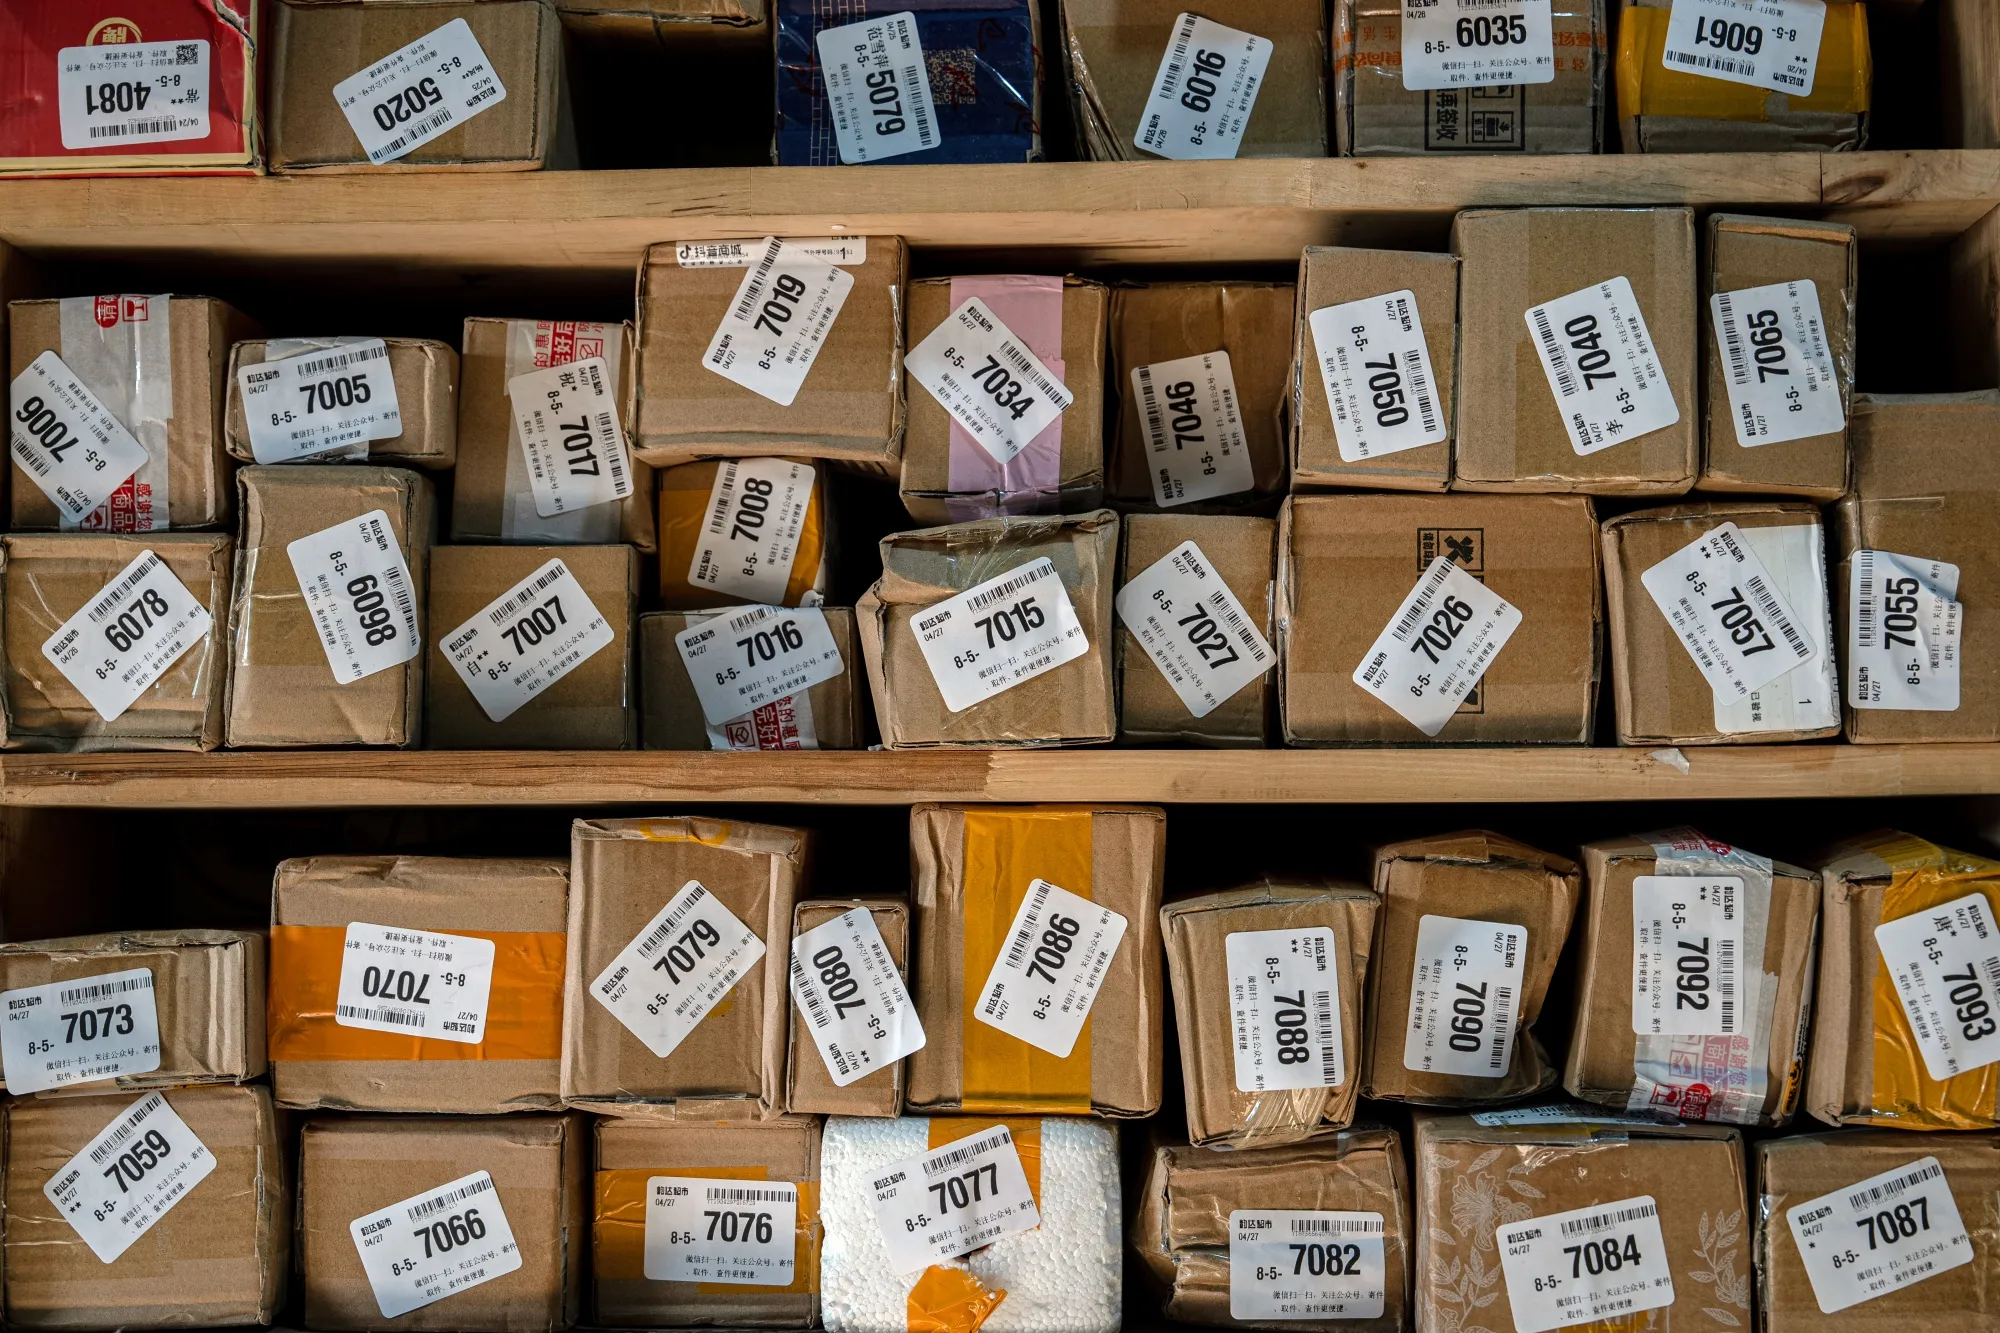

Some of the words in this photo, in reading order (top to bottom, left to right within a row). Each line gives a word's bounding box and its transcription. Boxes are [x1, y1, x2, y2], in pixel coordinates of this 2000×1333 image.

[886, 21, 897, 41] 04/25
[1424, 40, 1451, 55] 8-5-
[1455, 13, 1527, 48] 6035
[1694, 15, 1764, 56] 6061
[1771, 26, 1797, 42] 8-5-
[436, 56, 462, 75] 8-5-
[154, 74, 181, 88] 8-5-
[471, 76, 492, 92] 04/25
[853, 43, 870, 68] 8-5-
[865, 68, 906, 137] 5079
[1180, 48, 1227, 114] 6016
[85, 81, 152, 116] 4081
[372, 76, 444, 132] 5020
[178, 117, 199, 128] 04/24
[1436, 88, 1459, 141] 再签收
[1189, 120, 1207, 146] 8-5-
[694, 244, 742, 258] 抖音商城
[840, 246, 846, 260] 1
[752, 273, 807, 338] 7019
[1385, 300, 1397, 321] 04/27
[958, 313, 977, 331] 04/27
[722, 349, 737, 370] 04/27
[757, 346, 777, 370] 8-5-
[1564, 314, 1617, 392] 7040
[1746, 309, 1790, 384] 7065
[248, 383, 269, 395] 04/27
[578, 366, 590, 386] 04/27
[943, 346, 965, 370] 8-5-
[971, 353, 1036, 421] 7034
[1350, 325, 1369, 353] 8-5-
[1364, 351, 1410, 428] 7050
[271, 410, 298, 427] 8-5-
[298, 373, 372, 415] 7005
[1615, 387, 1636, 415] 8-5-
[1785, 385, 1803, 413] 8-5-
[1164, 380, 1206, 451] 7046
[1756, 415, 1768, 436] 04/27
[15, 395, 80, 464] 7006
[546, 390, 564, 416] 8-5-
[559, 414, 601, 477] 7017
[1589, 422, 1604, 443] 04/27
[85, 448, 107, 472] 8-5-
[1200, 450, 1217, 476] 8-5-
[73, 488, 92, 507] 04/27
[1172, 479, 1185, 498] 04/27
[136, 483, 153, 530] 感谢您
[729, 477, 774, 543] 7008
[1709, 537, 1728, 557] 04/27
[707, 563, 720, 584] 04/27
[741, 551, 758, 577] 8-5-
[1171, 556, 1189, 575] 04/27
[329, 550, 348, 577] 8-5-
[346, 574, 398, 647] 6098
[104, 588, 169, 653] 6078
[1685, 570, 1708, 597] 8-5-
[1710, 585, 1777, 658] 7057
[1883, 577, 1920, 651] 7055
[487, 660, 512, 681] 8-5-
[500, 594, 568, 657] 7007
[923, 626, 944, 642] 04/27
[953, 649, 980, 670] 8-5-
[973, 596, 1046, 650] 7015
[1152, 589, 1174, 614] 8-5-
[1177, 601, 1240, 670] 7027
[1409, 594, 1474, 665] 7026
[455, 644, 474, 662] 04/27
[687, 644, 707, 659] 04/27
[715, 666, 741, 686] 8-5-
[735, 619, 804, 668] 7016
[95, 658, 118, 680] 8-5-
[1372, 668, 1390, 689] 04/27
[1906, 657, 1921, 686] 8-5-
[1410, 673, 1431, 698] 8-5-
[1871, 680, 1882, 702] 04/27
[1750, 691, 1762, 723] 已验视
[1711, 885, 1721, 907] 04/27
[1671, 902, 1687, 930] 8-5-
[1955, 907, 1971, 929] 04/27
[652, 918, 721, 986] 7079
[1025, 912, 1081, 985] 7086
[1302, 936, 1313, 958] 04/27
[1493, 931, 1505, 954] 04/27
[1453, 944, 1469, 972] 8-5-
[362, 965, 431, 1005] 7070
[440, 971, 466, 988] 8-5-
[812, 945, 867, 1021] 7080
[1675, 936, 1711, 1011] 7092
[609, 983, 628, 1003] 04/27
[1922, 937, 1944, 966] 8-5-
[1941, 962, 1997, 1042] 7093
[8, 1010, 30, 1022] 04/27
[457, 1011, 478, 1022] 04/27
[646, 992, 670, 1016] 8-5-
[995, 999, 1010, 1021] 04/27
[1032, 994, 1052, 1021] 8-5-
[1265, 957, 1281, 985] 8-5-
[1273, 989, 1310, 1066] 7088
[1448, 981, 1488, 1053] 7090
[29, 1039, 55, 1055] 8-5-
[60, 1003, 135, 1044] 7073
[867, 1013, 887, 1040] 8-5-
[845, 1050, 861, 1071] 04/27
[102, 1129, 172, 1194] 7059
[59, 1187, 78, 1206] 04/27
[654, 1197, 676, 1207] 04/27
[876, 1187, 897, 1202] 04/27
[905, 1213, 932, 1233] 8-5-
[927, 1161, 999, 1216] 7077
[93, 1199, 117, 1222] 8-5-
[363, 1233, 383, 1248] 04/27
[670, 1230, 697, 1245] 8-5-
[703, 1210, 773, 1244] 7076
[1238, 1232, 1259, 1242] 04/27
[1802, 1222, 1823, 1238] 04/27
[1832, 1249, 1861, 1269] 8-5-
[1855, 1195, 1931, 1251] 7087
[391, 1257, 418, 1277] 8-5-
[412, 1208, 487, 1259] 7066
[1508, 1243, 1530, 1256] 04/27
[1256, 1266, 1283, 1281] 8-5-
[1288, 1243, 1361, 1277] 7082
[1534, 1274, 1563, 1292] 8-5-
[1562, 1233, 1642, 1279] 7084
